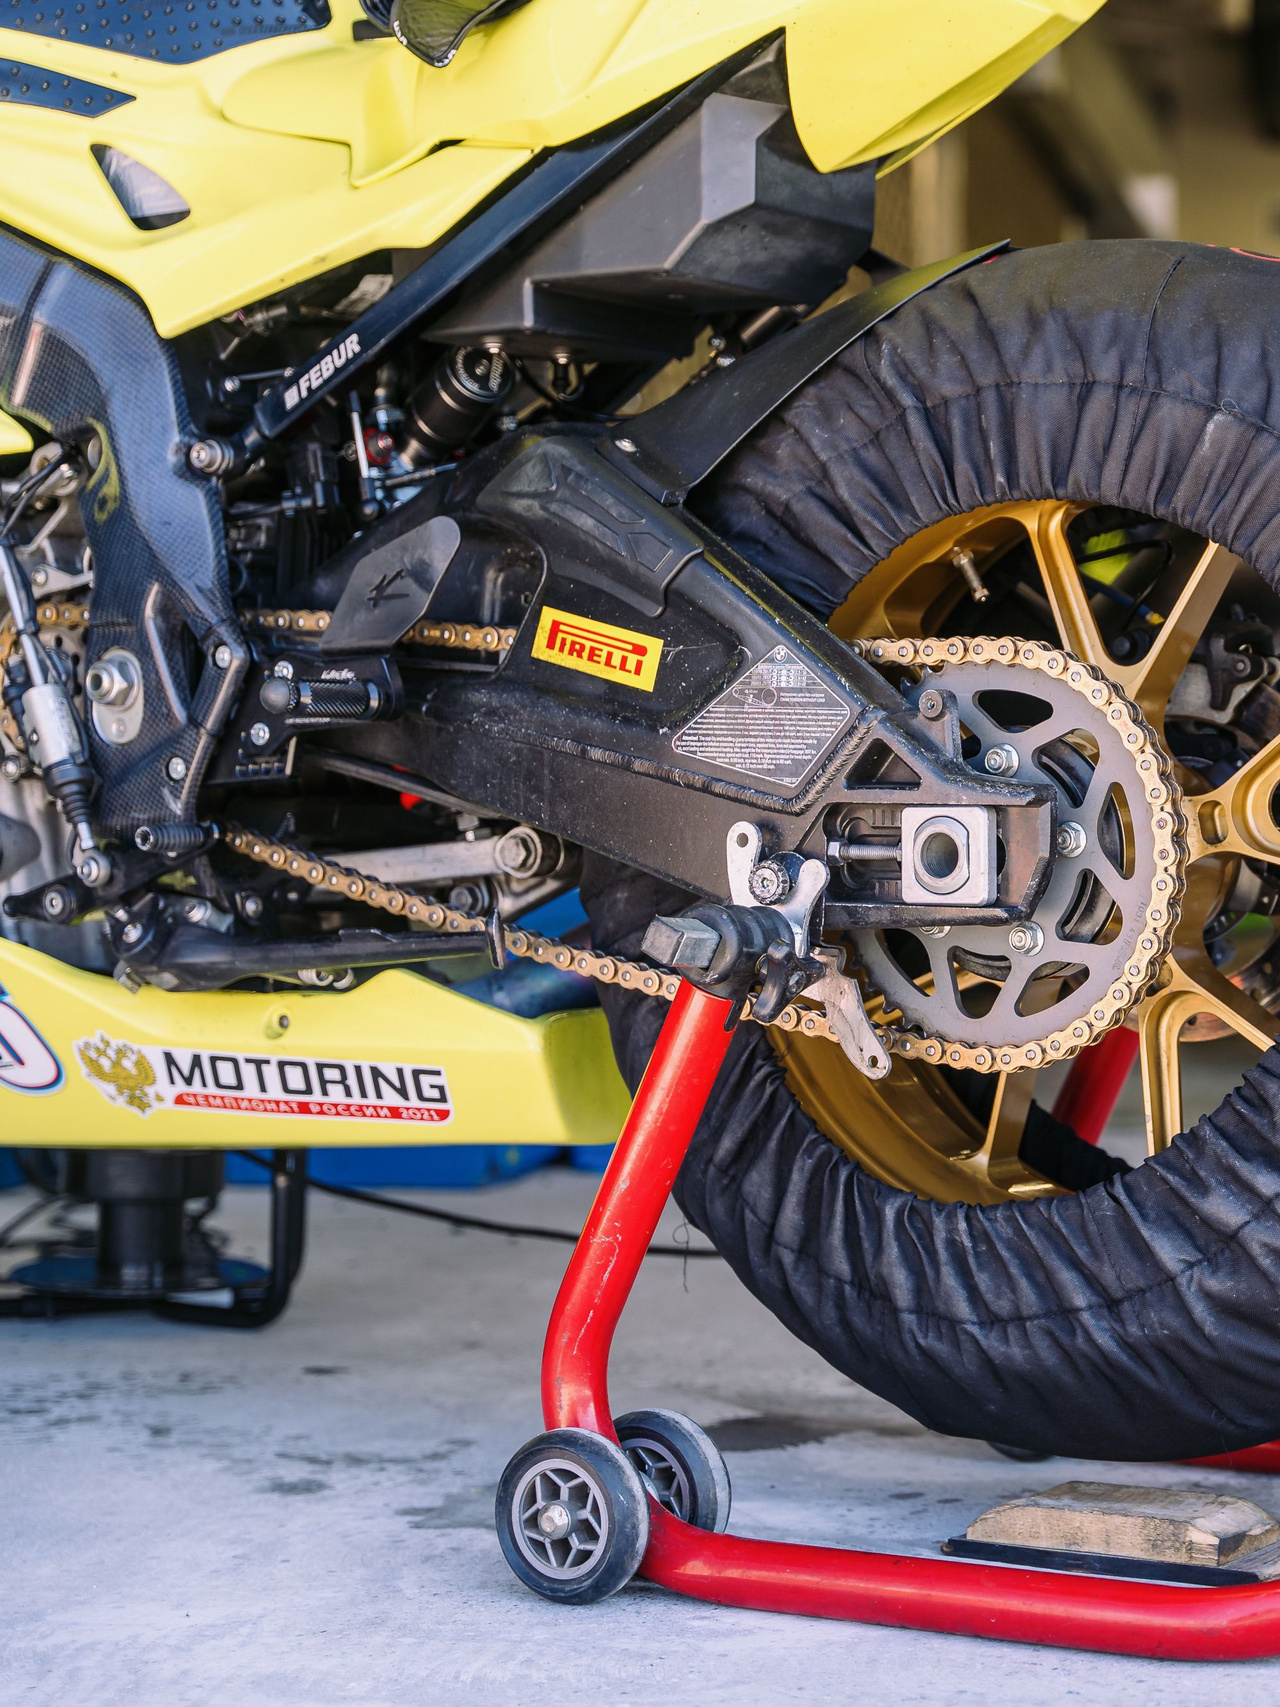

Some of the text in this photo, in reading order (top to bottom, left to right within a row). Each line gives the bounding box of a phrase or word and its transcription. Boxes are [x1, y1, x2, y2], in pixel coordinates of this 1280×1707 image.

[298, 332, 362, 399] FEBUR
[545, 619, 648, 677] PIRELLI
[162, 1050, 449, 1105] MOTORING
[182, 1093, 440, 1121] ЧЕМПИОНАТ РОССИИ 2021
